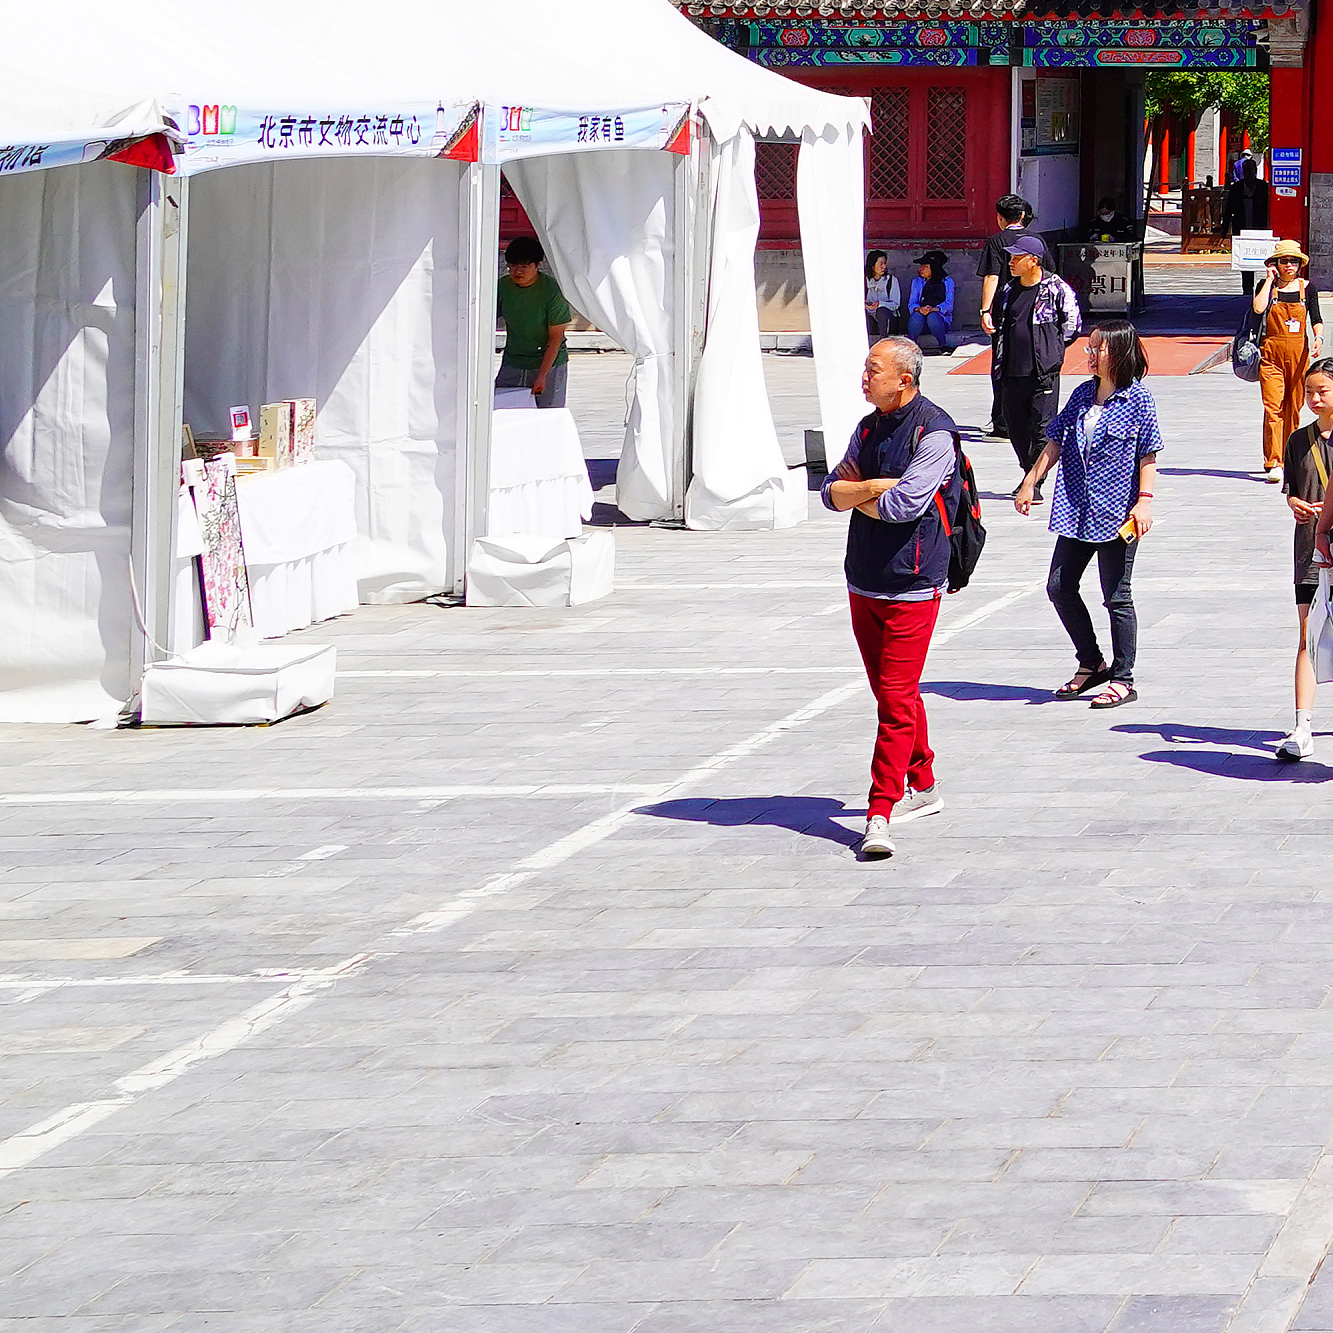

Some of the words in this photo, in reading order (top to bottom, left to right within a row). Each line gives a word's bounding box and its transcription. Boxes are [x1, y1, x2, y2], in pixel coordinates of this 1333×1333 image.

[257, 114, 421, 149] 北京市文物交流中心
[577, 115, 625, 143] 我家有鱼
